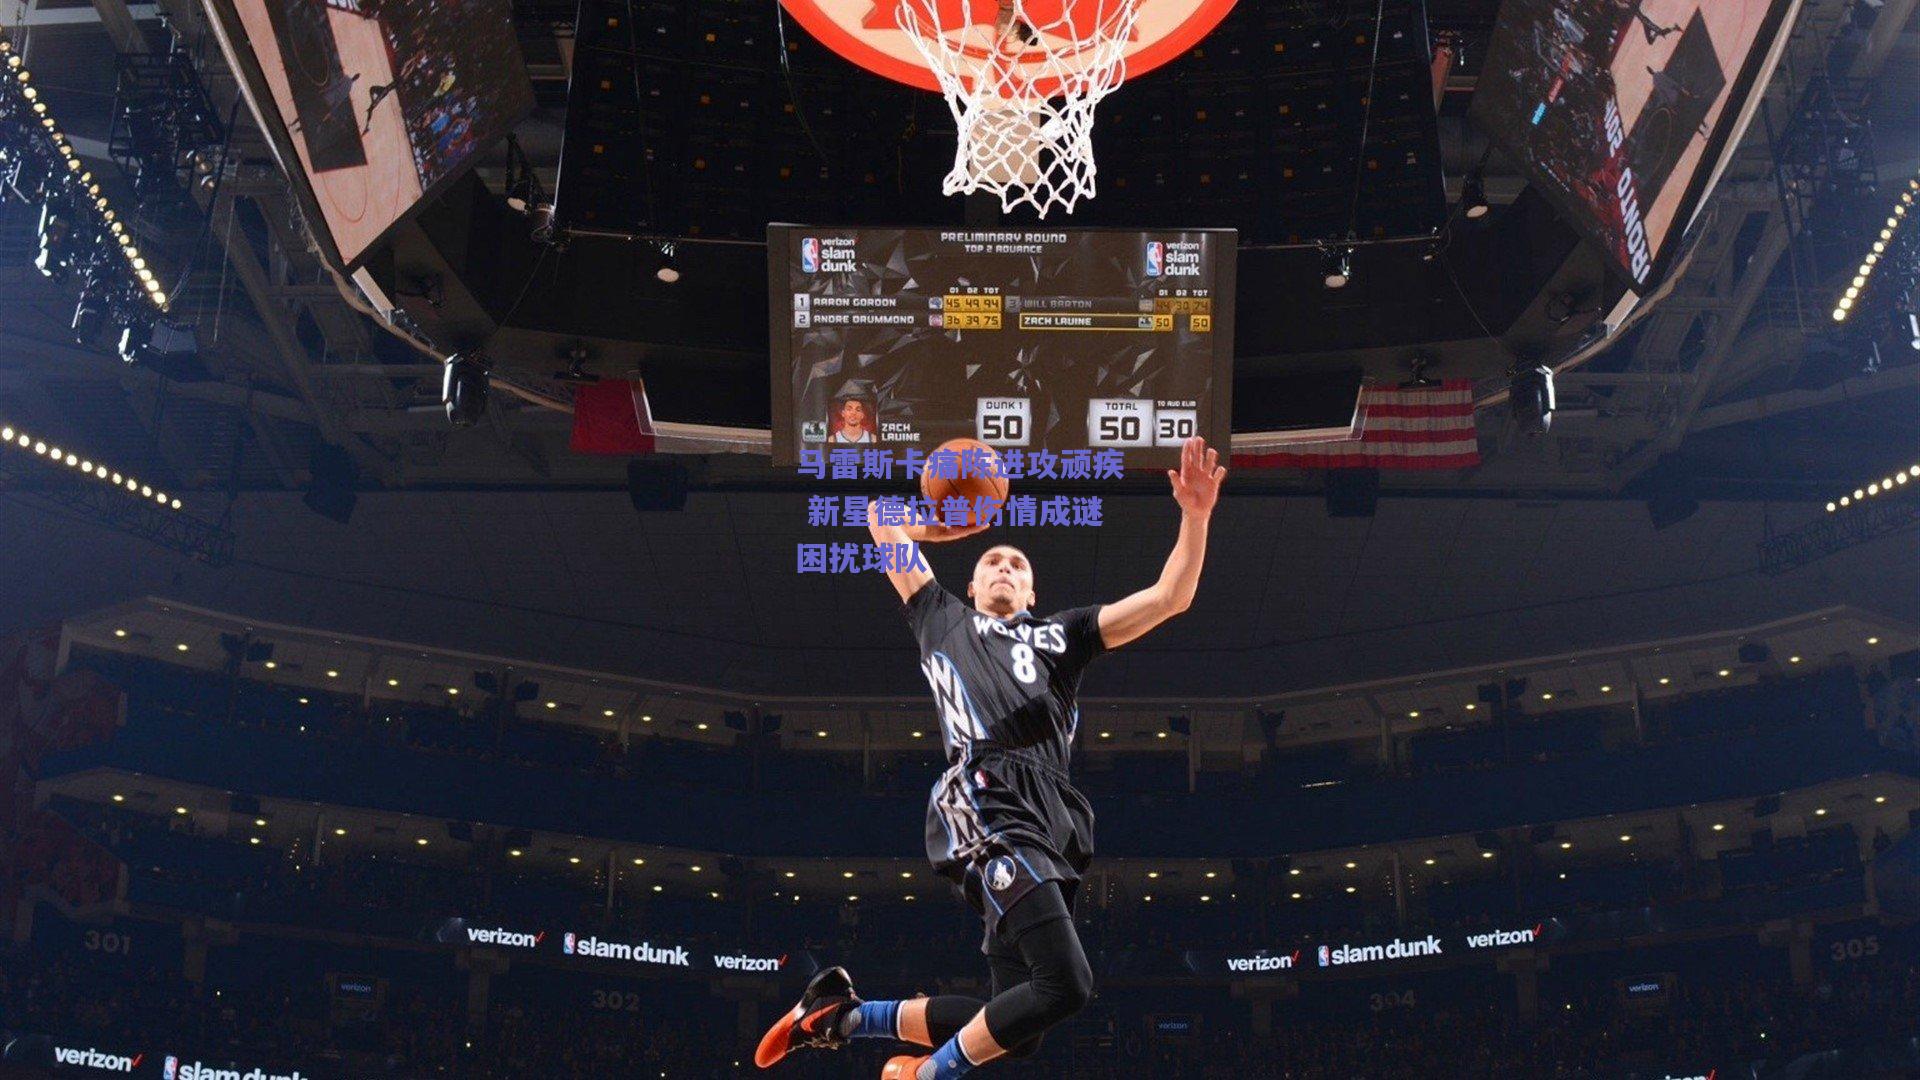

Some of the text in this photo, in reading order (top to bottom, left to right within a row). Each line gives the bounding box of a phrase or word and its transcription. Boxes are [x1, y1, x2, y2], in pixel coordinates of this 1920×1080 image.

[1617, 167, 1650, 284] RONTO
[821, 238, 854, 246] verizon
[940, 232, 1067, 243] PRELIMINARY ROUND
[964, 244, 984, 252] TOP
[996, 245, 1042, 254] ADVANCE
[1166, 241, 1199, 250] verizon
[821, 247, 855, 260] slam
[1166, 251, 1199, 263] slam
[820, 260, 856, 272] dunk
[1164, 263, 1200, 276] dunk
[983, 286, 1000, 294] TOT
[800, 298, 998, 308] 1 AARON GORDON 45 49 94
[1050, 300, 1092, 308] BARTON
[799, 314, 998, 325] 2 ANDRE DRUMMOND 36 39 75
[1024, 316, 1208, 327] ZACH LAVINE 50 50
[986, 402, 1023, 410] DUNK 1
[1105, 402, 1138, 410] TOTAL
[882, 423, 910, 432] ZACH
[983, 415, 1023, 440] 50
[1100, 416, 1140, 440] 50
[1160, 418, 1193, 438] 30
[882, 432, 920, 442] LAVINE
[1011, 643, 1037, 684] 8
[467, 927, 536, 948] verizon
[1466, 926, 1533, 949] verizon
[577, 936, 690, 966] slam dunk
[1331, 934, 1442, 964] slam dunk
[714, 954, 779, 972] verizon
[1227, 953, 1291, 972] verizon
[340, 982, 372, 994] verizon
[1628, 982, 1660, 993] verizon
[54, 1046, 132, 1072] verizon
